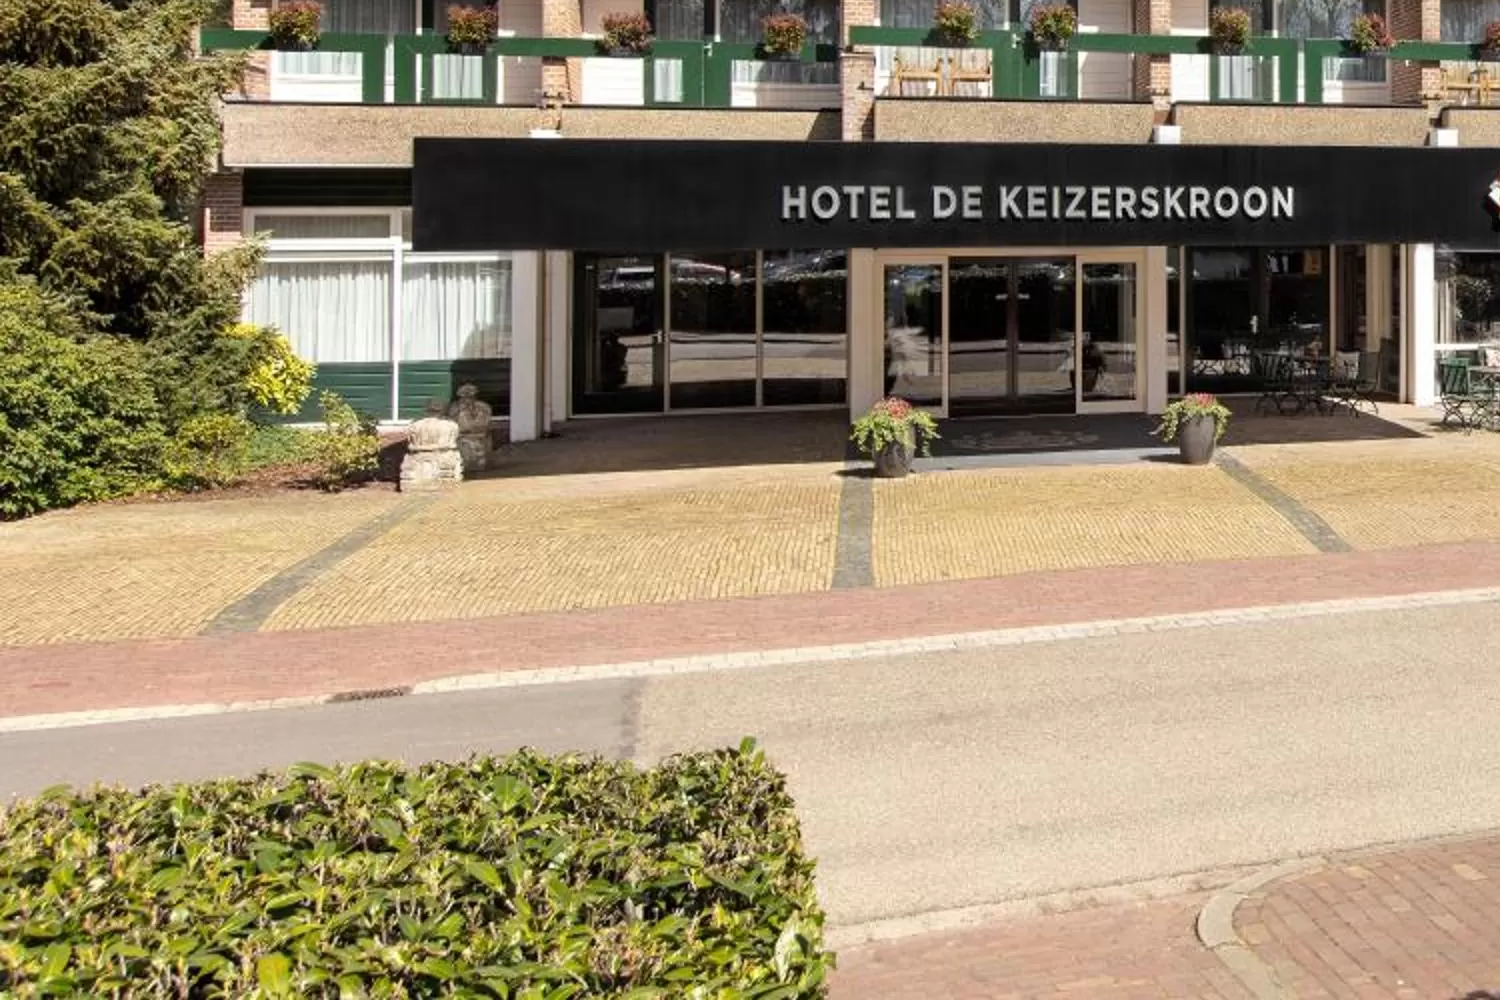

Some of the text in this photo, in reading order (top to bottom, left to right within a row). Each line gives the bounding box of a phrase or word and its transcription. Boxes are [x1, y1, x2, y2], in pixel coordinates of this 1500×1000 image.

[781, 185, 1295, 219] HOTEL DE KEIZERSKROON
